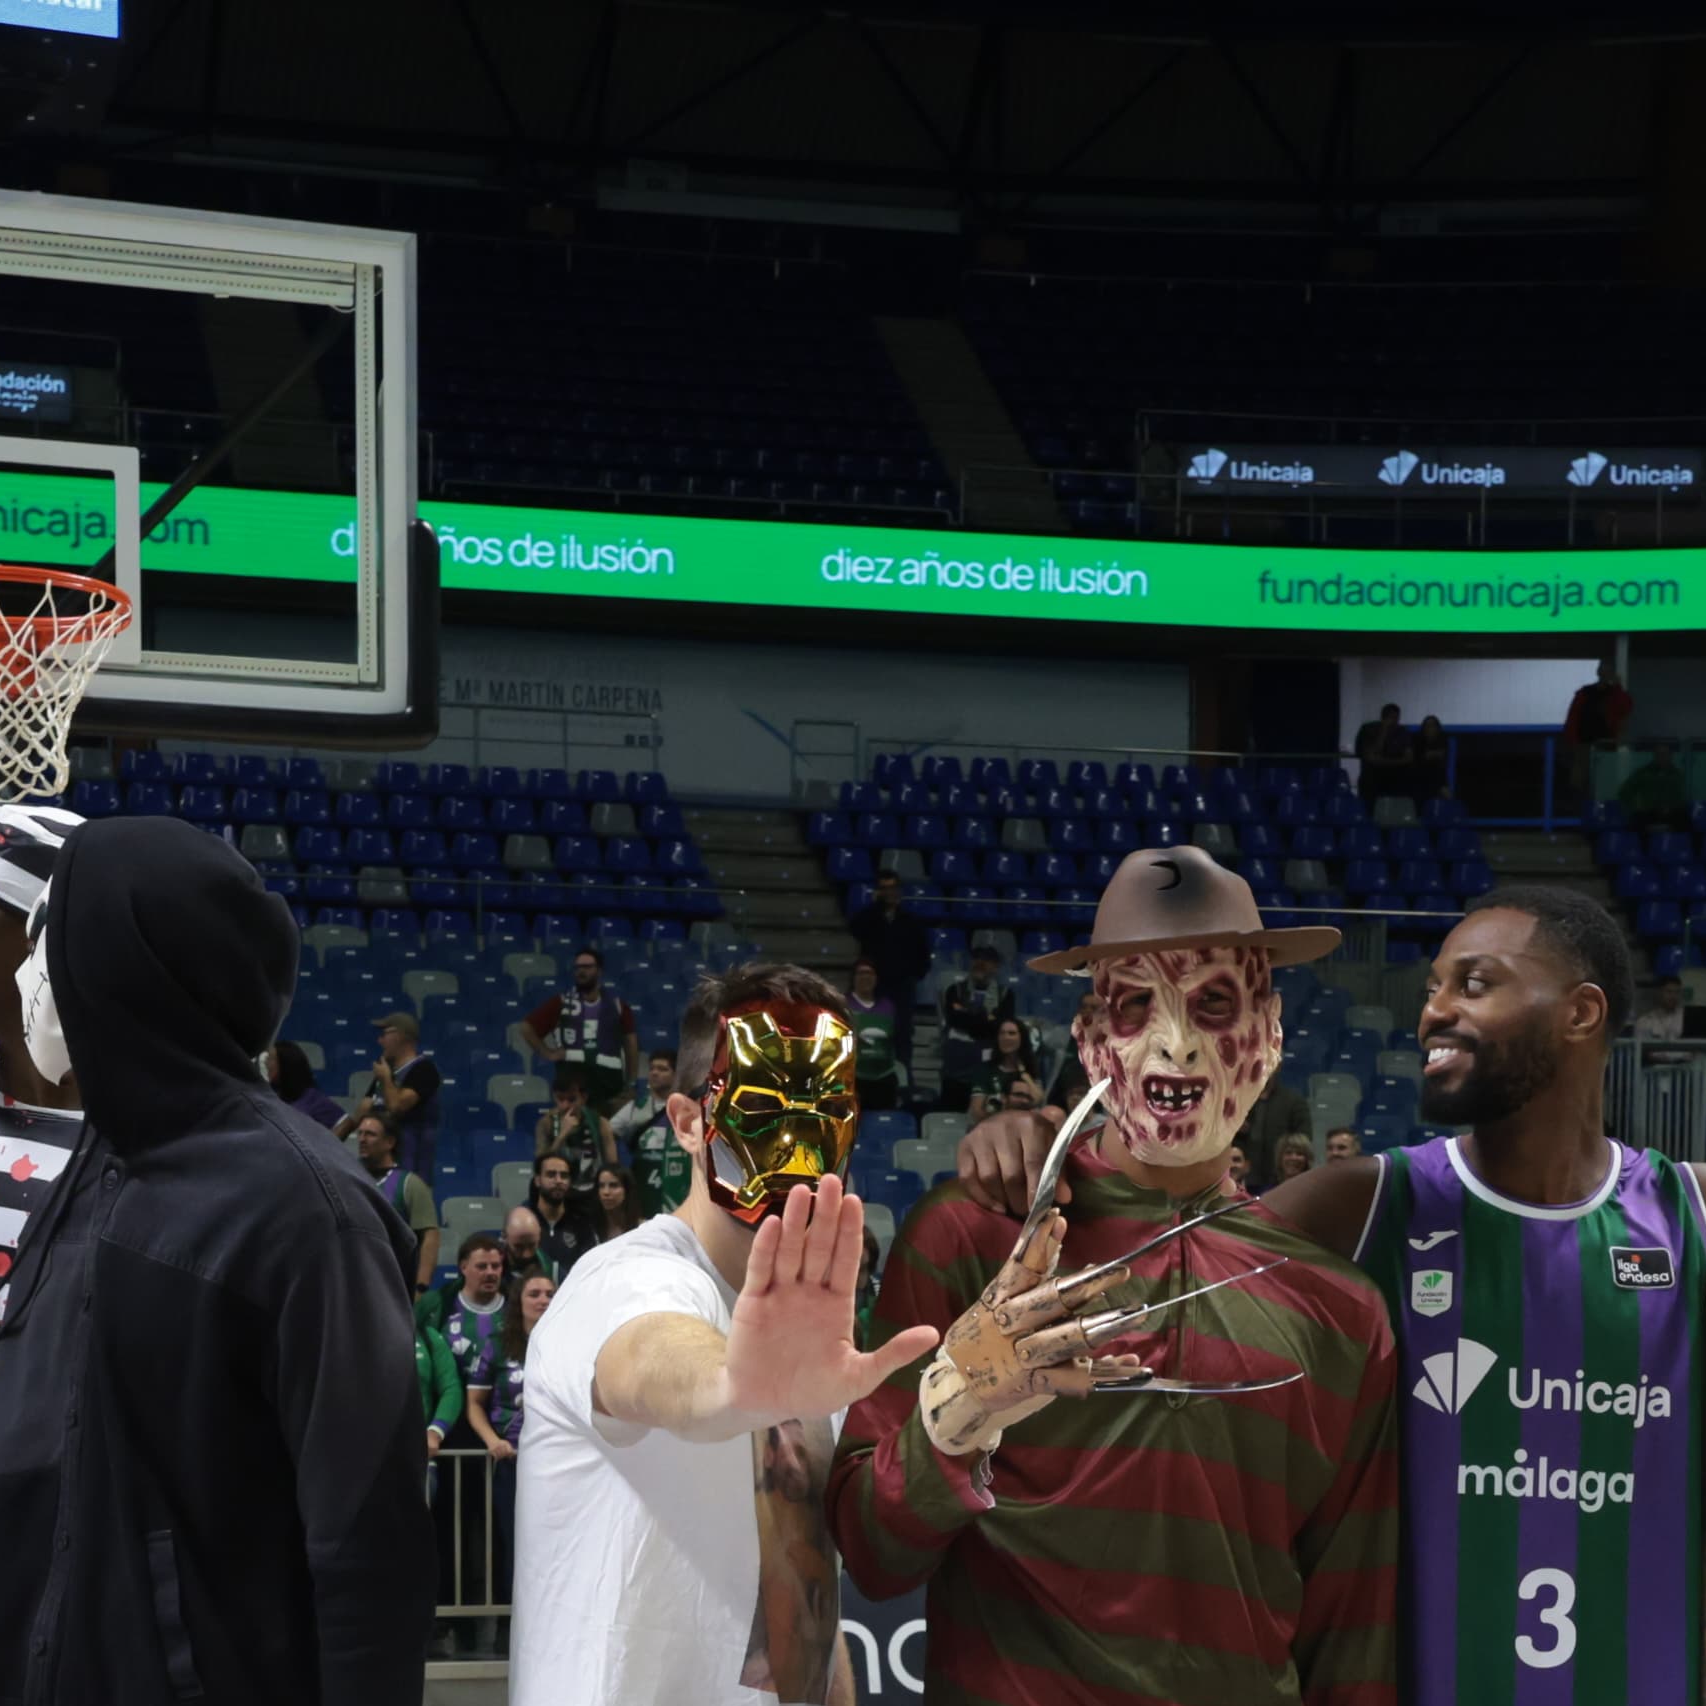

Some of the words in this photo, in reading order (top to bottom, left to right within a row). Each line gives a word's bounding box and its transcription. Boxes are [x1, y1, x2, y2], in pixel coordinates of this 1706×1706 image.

[1229, 460, 1314, 488] Unicaja
[1420, 462, 1506, 489] Unicaja
[1608, 464, 1693, 492] Unicaja
[438, 526, 503, 567] ños
[507, 532, 555, 568] de
[560, 533, 674, 575] ilusión
[820, 547, 895, 585] diez
[898, 550, 985, 589] años
[988, 556, 1035, 592] de
[1039, 558, 1148, 597] ilusión
[1257, 568, 1680, 618] fundacionunicaja.com
[572, 683, 664, 712] CARPENA
[1617, 1258, 1640, 1272] liga
[1618, 1270, 1670, 1284] endesa
[1508, 1366, 1672, 1428] Unicaja
[1514, 1567, 1578, 1669] 3
